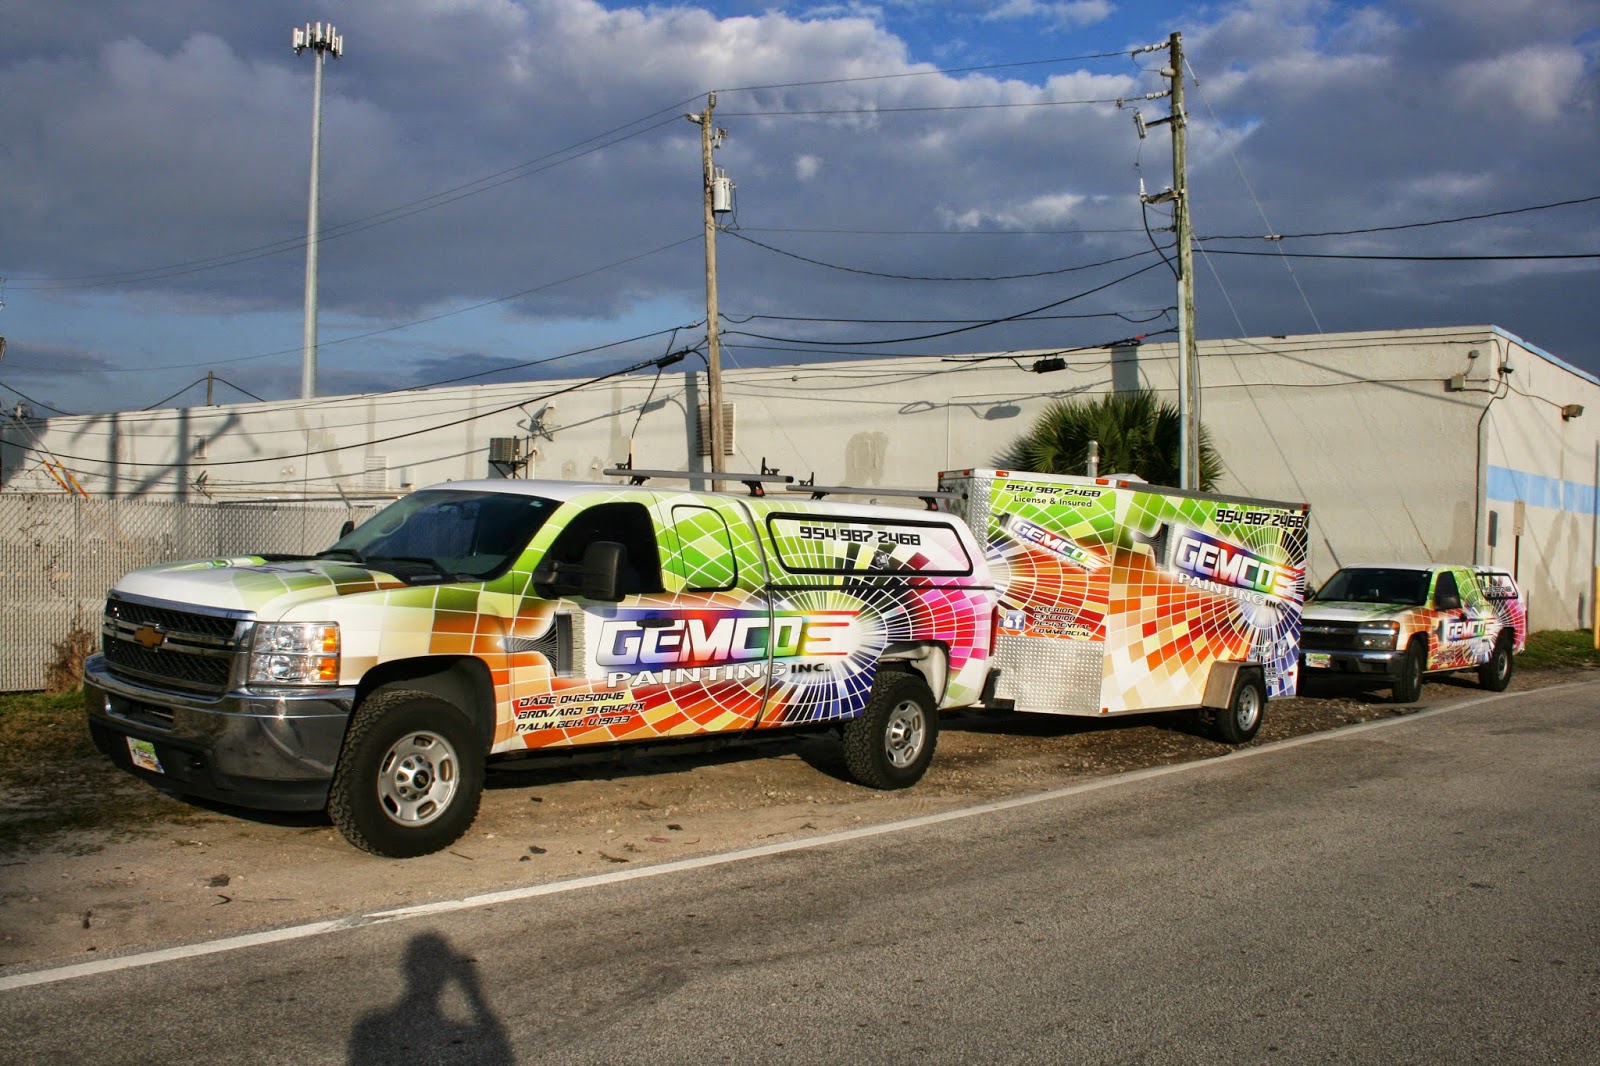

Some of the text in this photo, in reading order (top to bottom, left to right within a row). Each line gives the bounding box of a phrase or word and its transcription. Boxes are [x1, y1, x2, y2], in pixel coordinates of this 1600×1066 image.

[1064, 488, 1101, 498] 2468
[1014, 494, 1092, 508] License & Insured
[877, 531, 921, 546] 2468
[1012, 520, 1088, 562] GEMCO
[1175, 535, 1277, 594] GEMCO
[1178, 572, 1265, 606] PAINTING
[1034, 605, 1074, 614] INTERIOR
[1033, 613, 1076, 622] EXTERIOR
[1033, 628, 1092, 637] COMMERCIAL
[596, 616, 803, 667] GEMCO
[607, 661, 831, 688] PAINTING INC.
[519, 695, 557, 707] DADE
[517, 707, 583, 720] BROWARD
[515, 719, 555, 732] PALM
